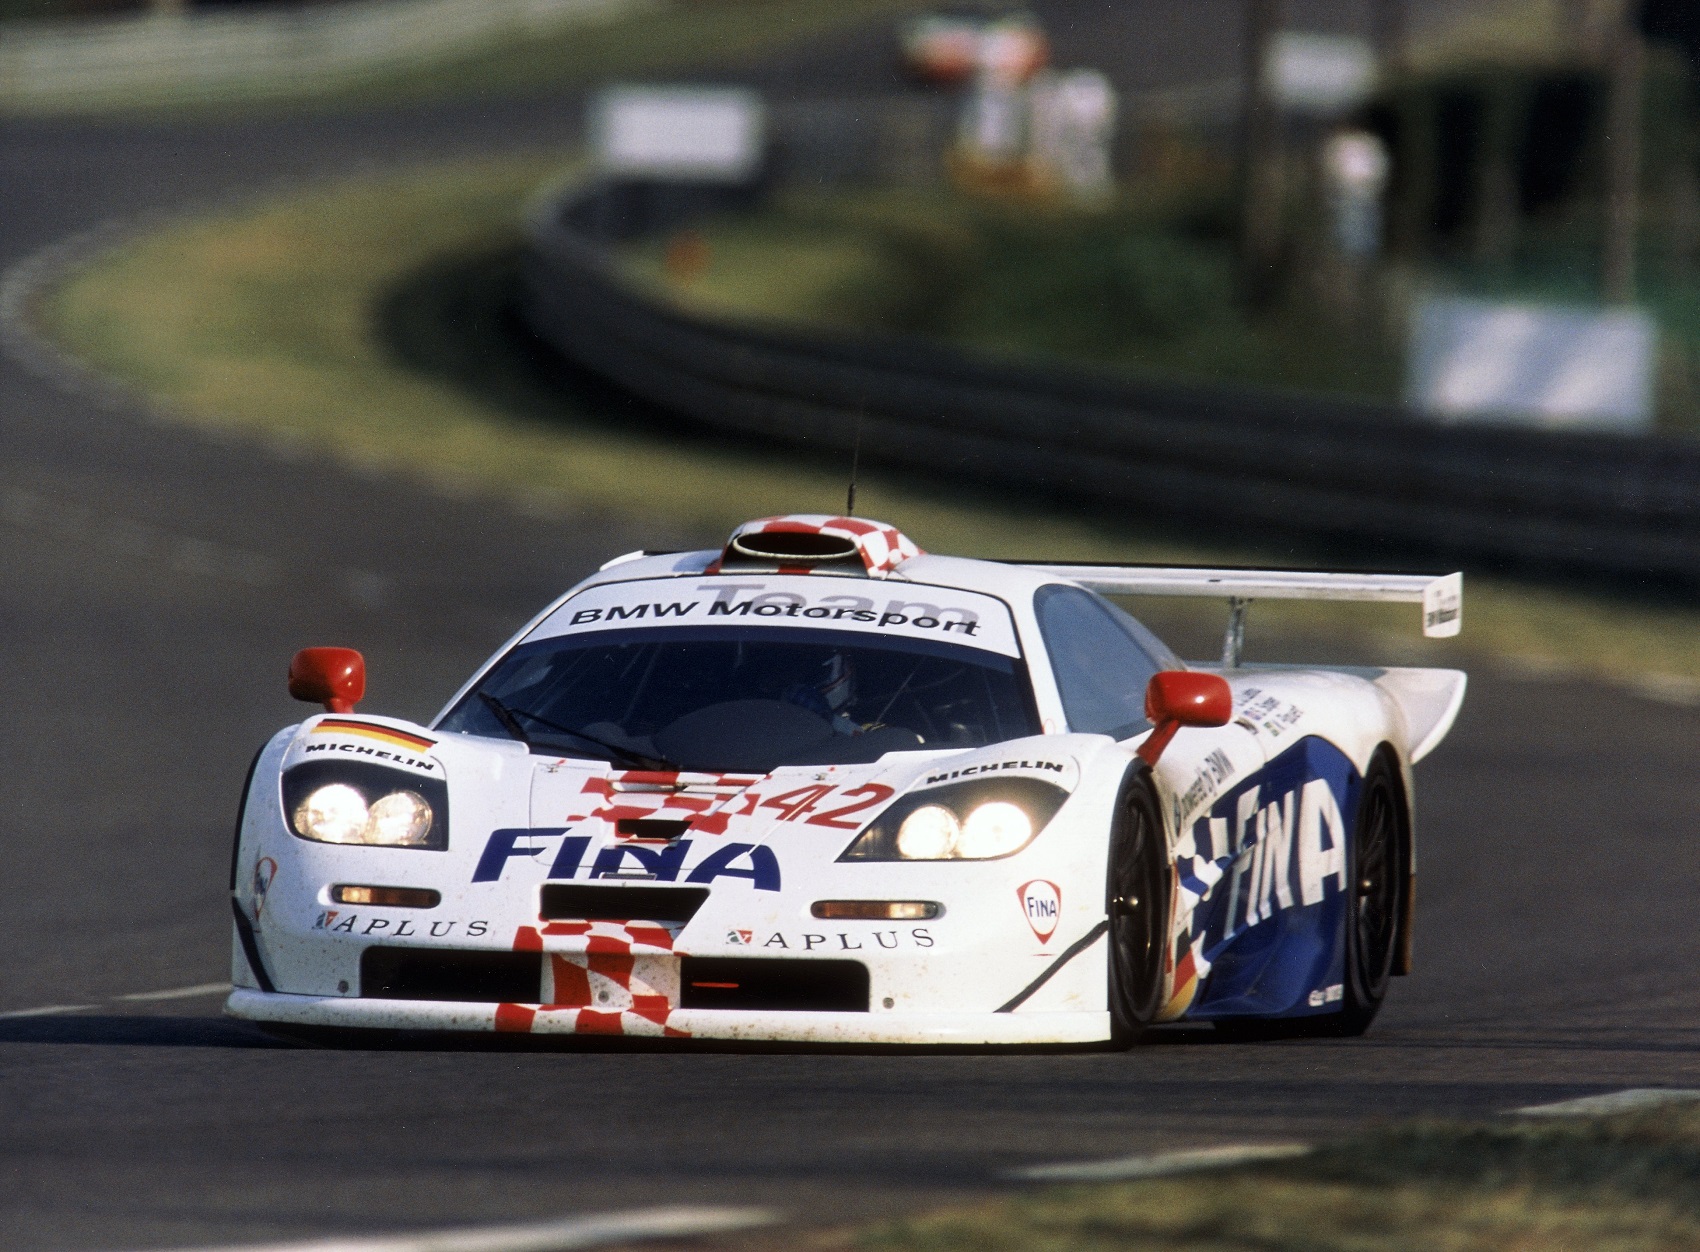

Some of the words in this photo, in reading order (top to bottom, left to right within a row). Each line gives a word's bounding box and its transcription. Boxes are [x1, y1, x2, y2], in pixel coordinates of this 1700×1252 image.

[568, 600, 700, 627] BMW
[707, 600, 982, 637] Motorsport
[696, 583, 980, 635] Team
[305, 743, 435, 771] MICHELIN
[926, 761, 1064, 784] MICHELIN
[759, 783, 896, 830] 42
[471, 827, 782, 893] FINA
[1223, 779, 1348, 940] FINA
[1026, 896, 1058, 918] FINA
[333, 914, 489, 938] APLUS
[763, 928, 936, 950] APLUS
